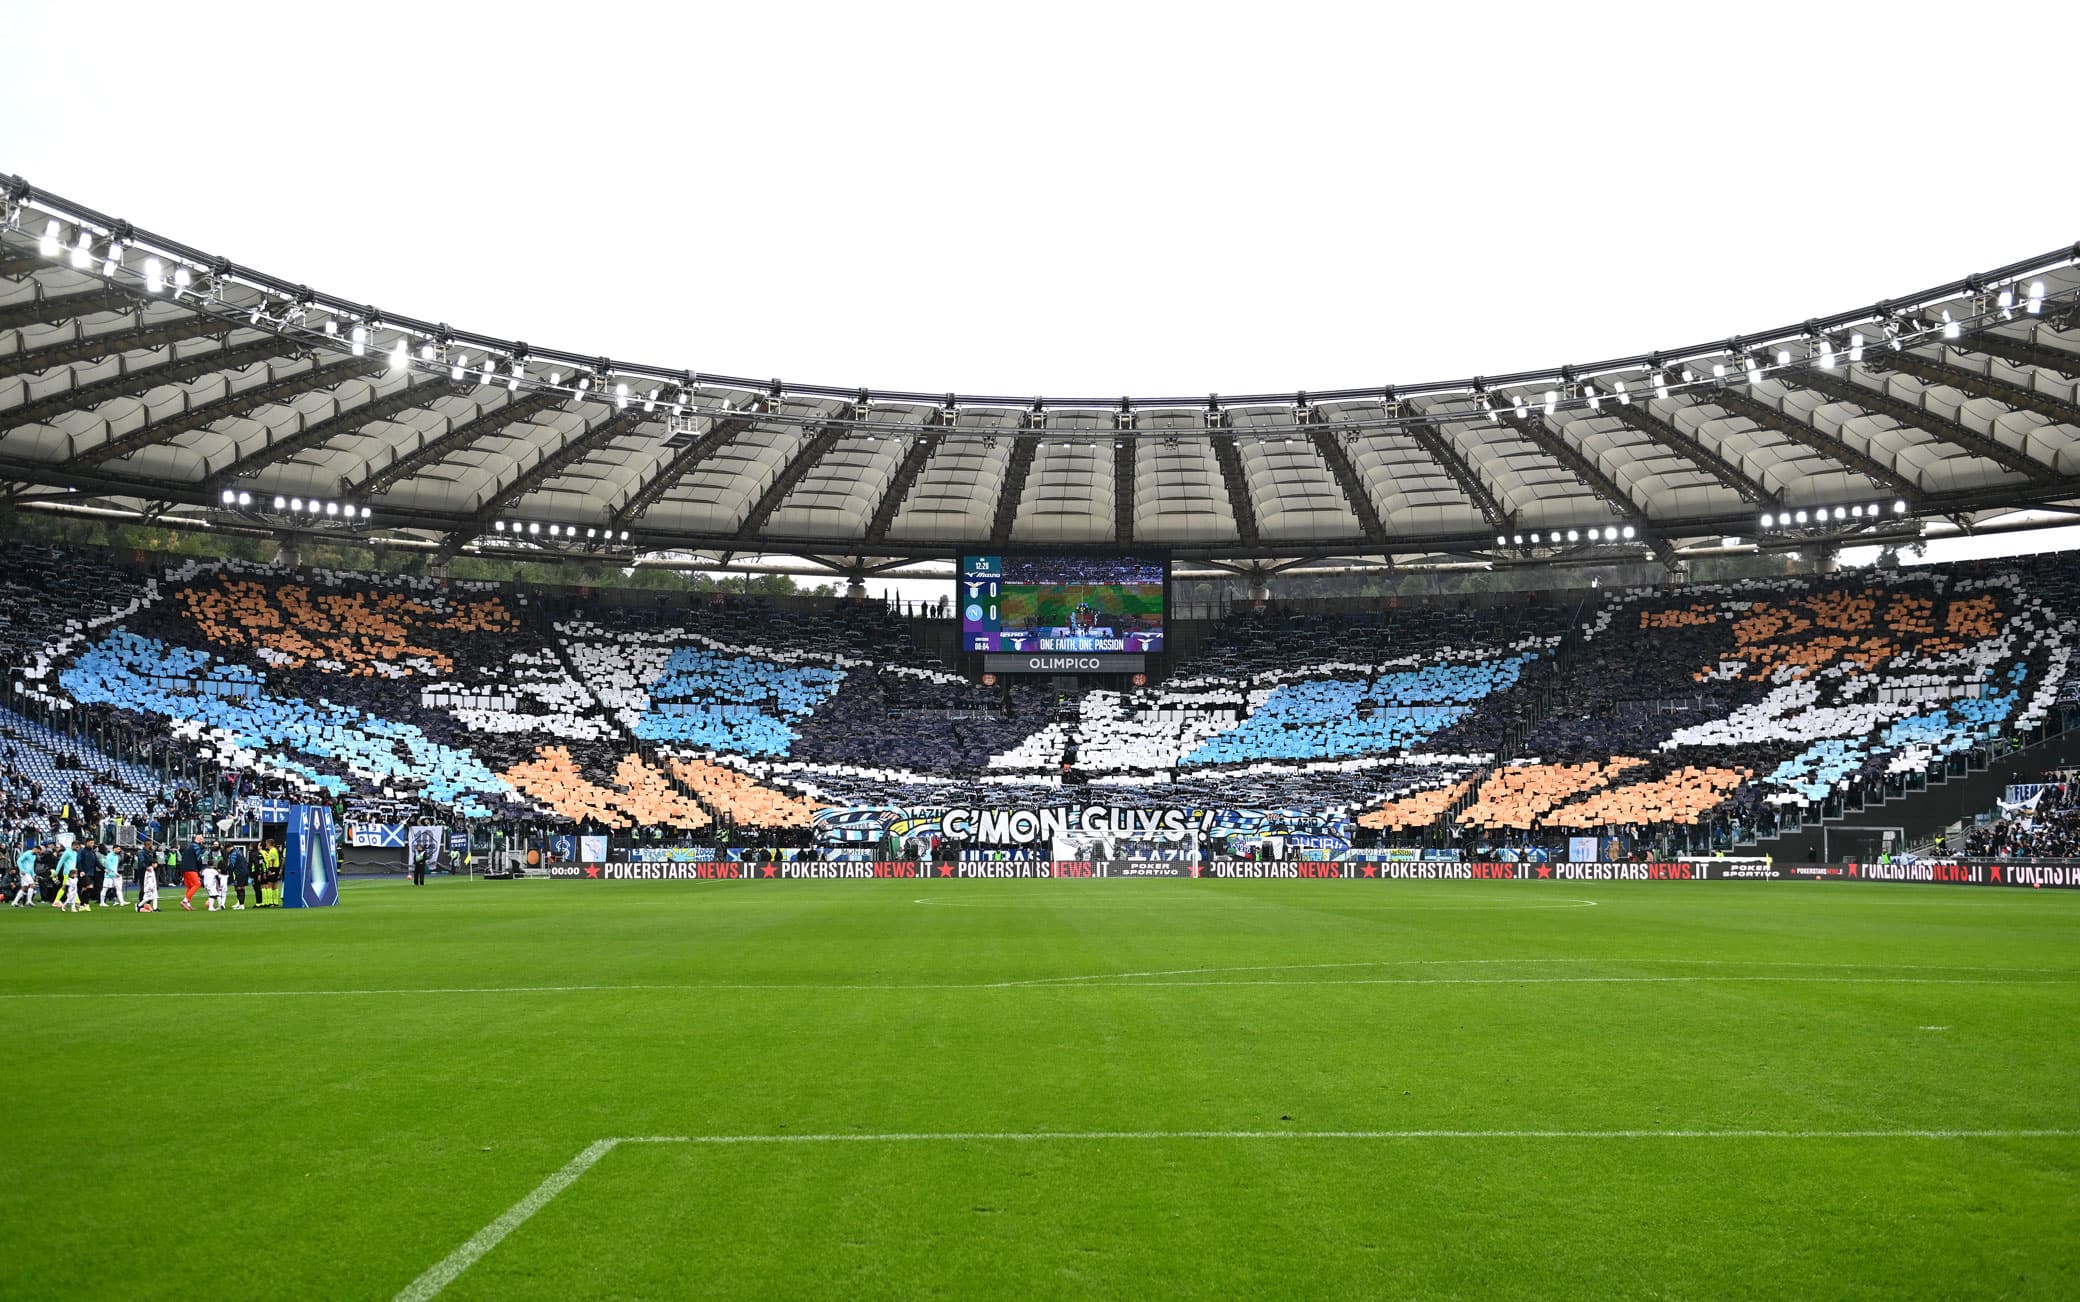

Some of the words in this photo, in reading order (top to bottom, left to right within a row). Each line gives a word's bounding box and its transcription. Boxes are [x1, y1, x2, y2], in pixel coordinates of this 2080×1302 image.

[990, 582, 997, 598] 0
[990, 605, 997, 621] 0
[1040, 639, 1054, 650] ONE
[1079, 639, 1093, 650] ONE
[1094, 639, 1124, 650] PASSION
[1029, 658, 1100, 669] OLIMPICO
[942, 807, 1067, 844] C'MON
[551, 867, 580, 875] 00:00
[604, 863, 757, 879] POKERSTARSNEWS.IT
[781, 862, 933, 878] POKERSTARSNEWS.IT
[1381, 863, 1531, 879] POKERSTARSNEWS.IT
[1556, 863, 1709, 880] POKERSTARSNEWS.IT
